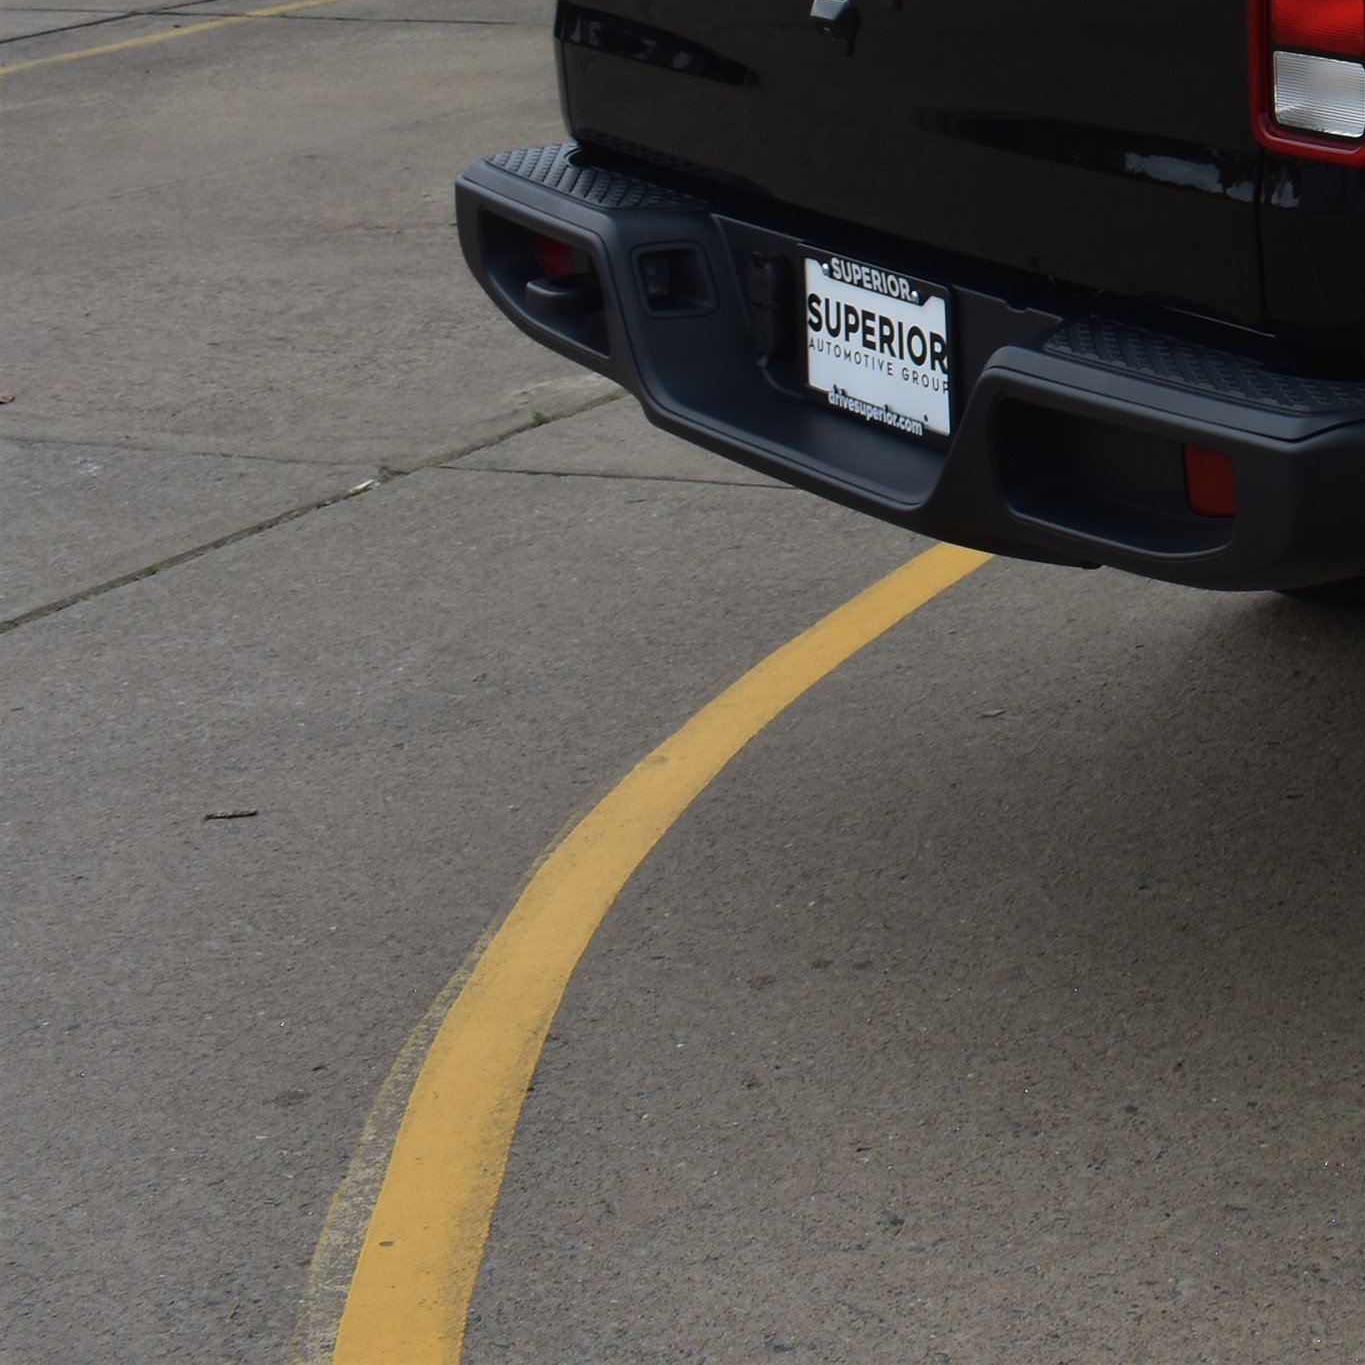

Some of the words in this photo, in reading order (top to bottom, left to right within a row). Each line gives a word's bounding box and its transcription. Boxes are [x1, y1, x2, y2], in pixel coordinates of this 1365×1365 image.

[831, 257, 912, 302] SUPERIOR
[807, 293, 948, 375] SUPERIOR
[809, 337, 893, 376] AUTOMOTIVE
[902, 367, 949, 394] GROUP
[828, 387, 923, 436] drivesuperior.com
